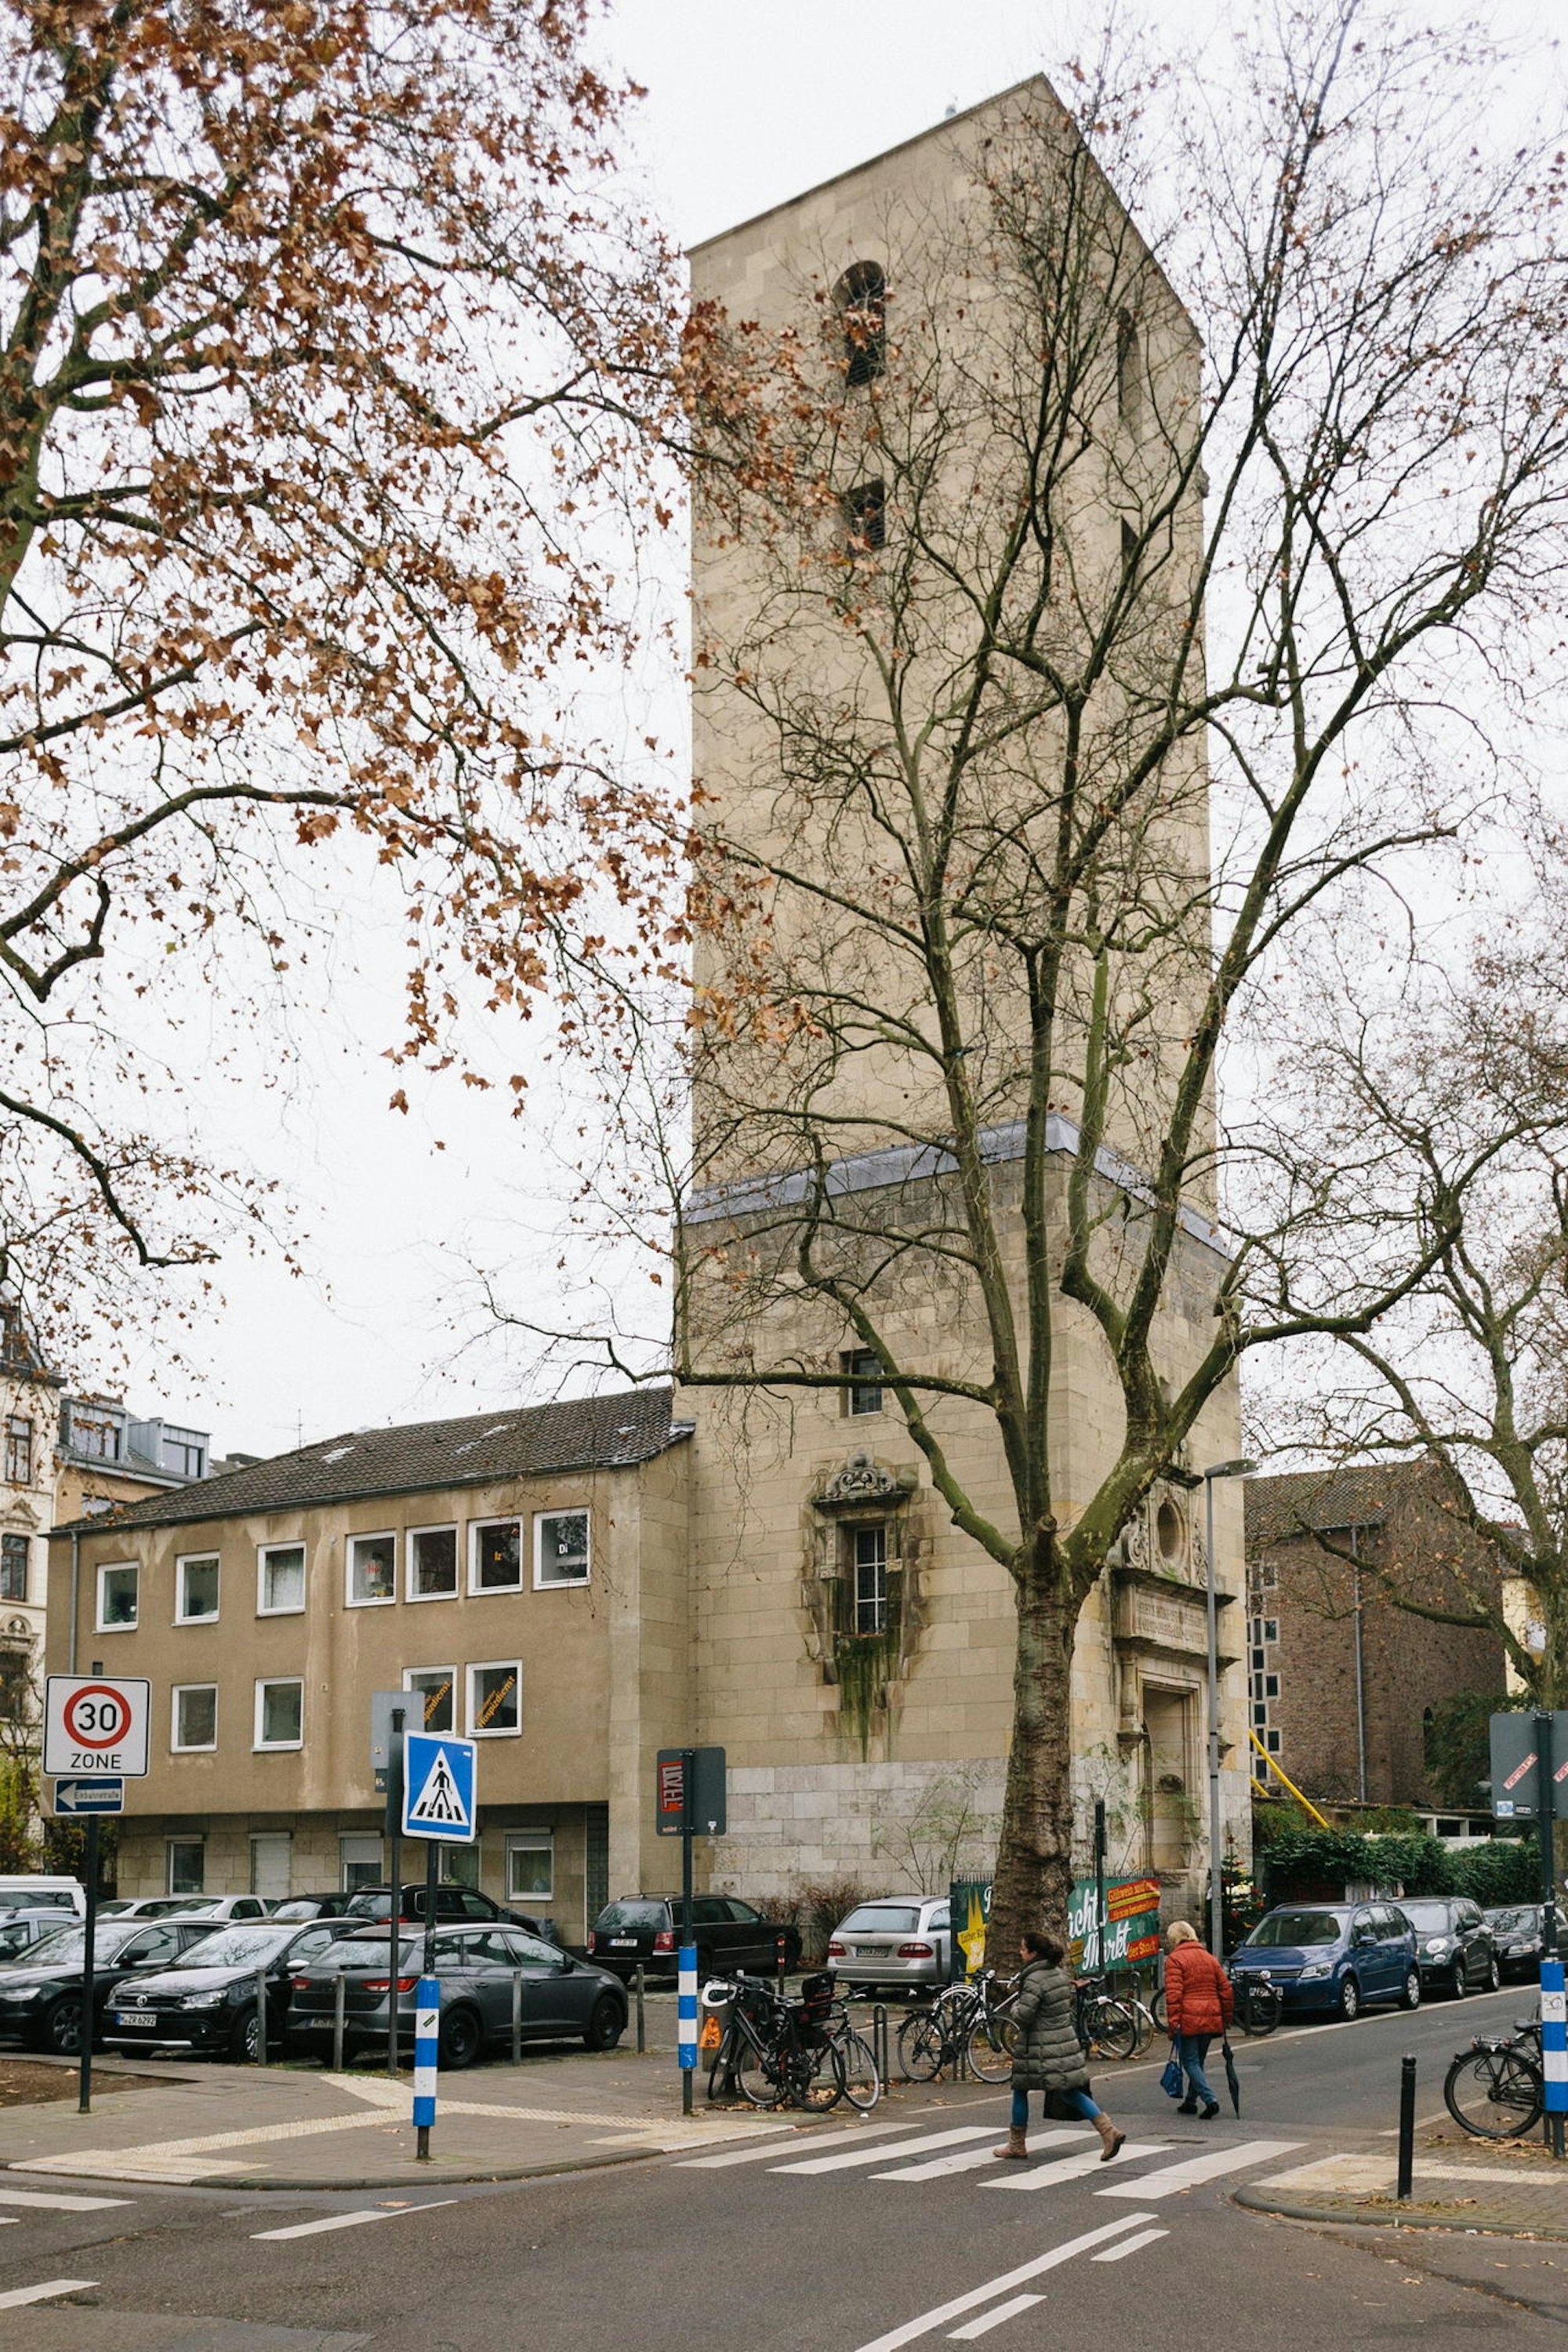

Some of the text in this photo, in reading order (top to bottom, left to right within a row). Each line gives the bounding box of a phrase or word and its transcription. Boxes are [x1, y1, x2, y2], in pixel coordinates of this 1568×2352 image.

[476, 1675, 516, 1728] Hospizdienst
[78, 1702, 117, 1731] 30
[71, 1753, 122, 1769] ZONE
